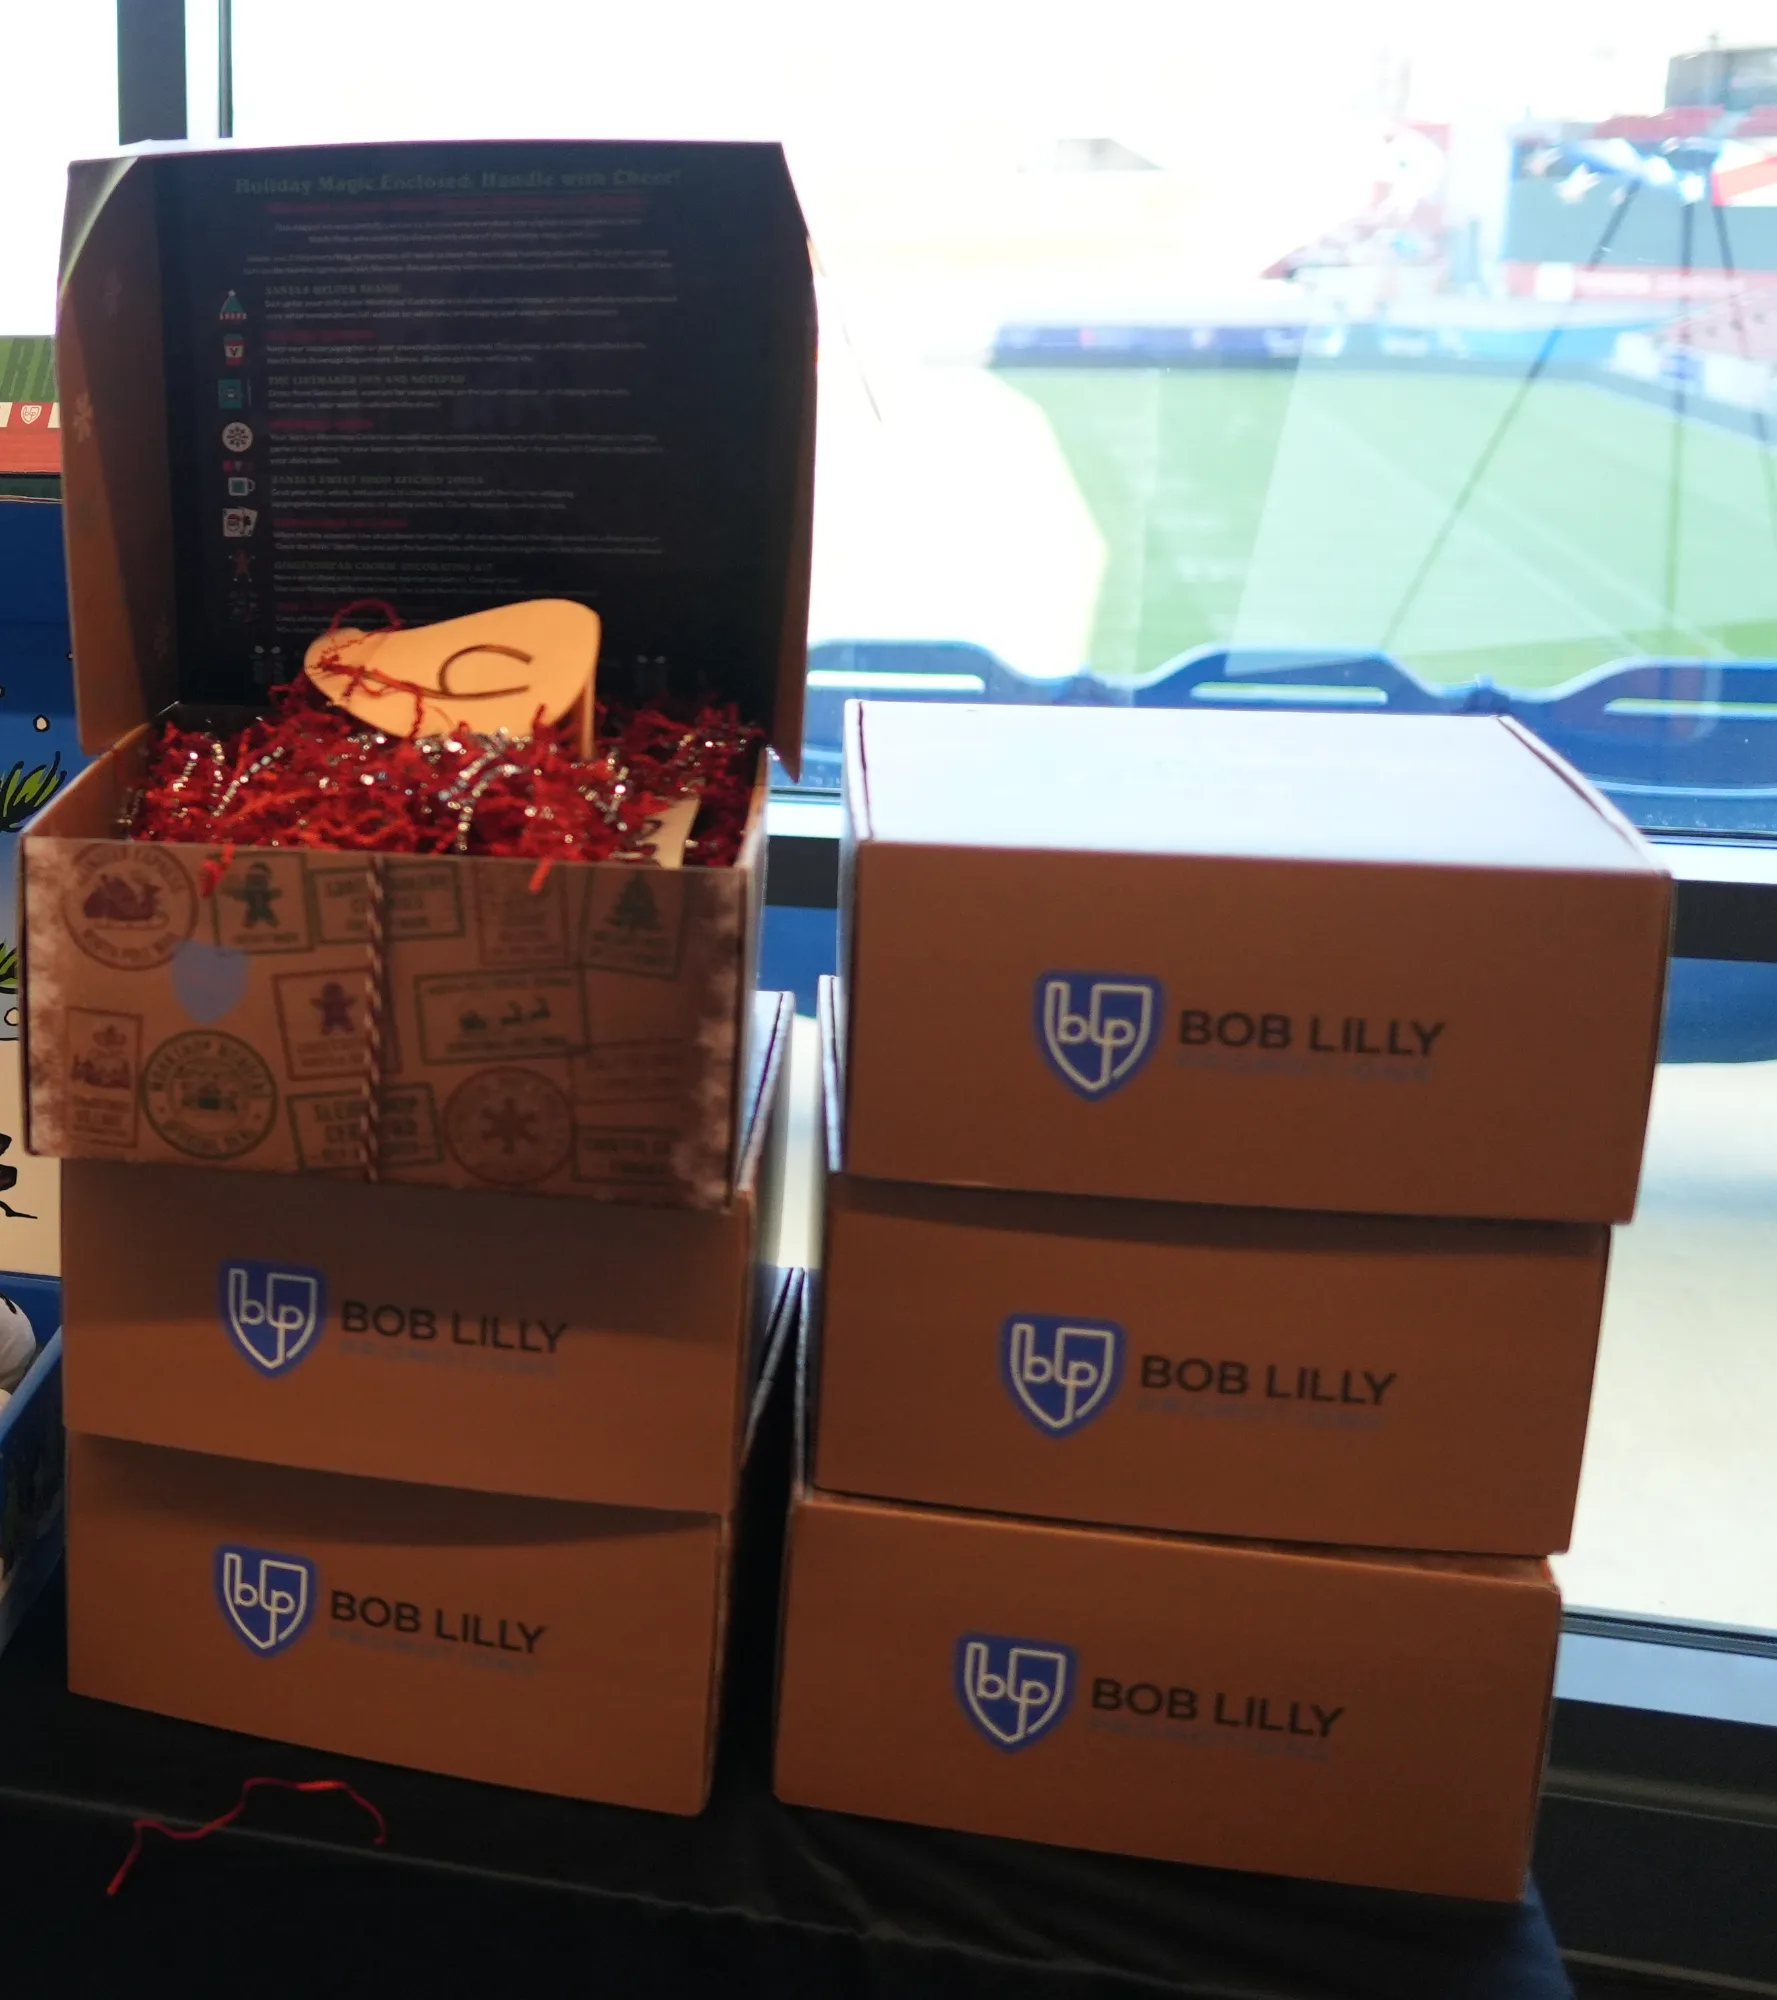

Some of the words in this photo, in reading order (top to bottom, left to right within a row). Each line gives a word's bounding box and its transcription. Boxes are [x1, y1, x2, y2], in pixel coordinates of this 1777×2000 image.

[235, 178, 312, 196] Holiday
[1179, 1008, 1293, 1049] BOB
[1309, 1015, 1446, 1057] LILLY
[342, 1299, 438, 1341] BOB
[452, 1311, 568, 1353] LILLY
[1140, 1353, 1250, 1396] BOB
[1266, 1365, 1398, 1406] LILLY
[330, 1590, 421, 1634] BOB
[435, 1608, 547, 1654] LILLY
[1091, 1676, 1198, 1721] BOB
[1214, 1692, 1345, 1738] LILLY
